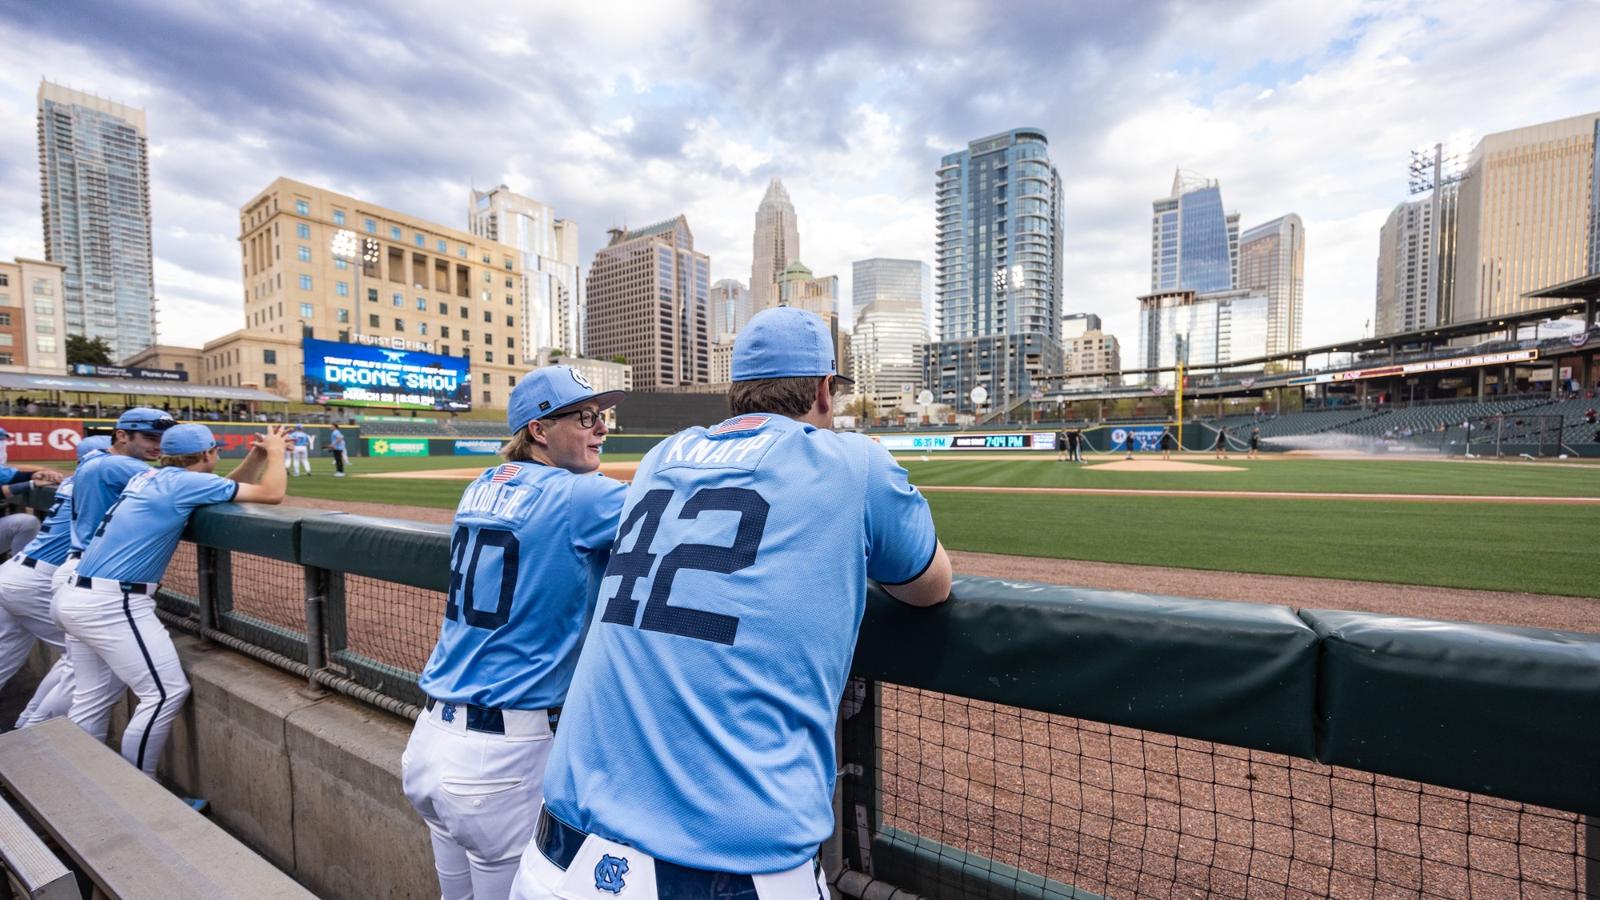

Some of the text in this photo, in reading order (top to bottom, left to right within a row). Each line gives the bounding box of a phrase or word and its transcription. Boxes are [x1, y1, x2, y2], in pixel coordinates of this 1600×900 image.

[352, 333, 434, 352] TRUIST FIELD
[325, 365, 457, 391] DRONE SHOW
[665, 433, 773, 464] KNAPP
[986, 436, 1005, 447] 7:04
[1008, 436, 1023, 447] PM
[446, 525, 520, 631] 40
[600, 487, 770, 646] 42
